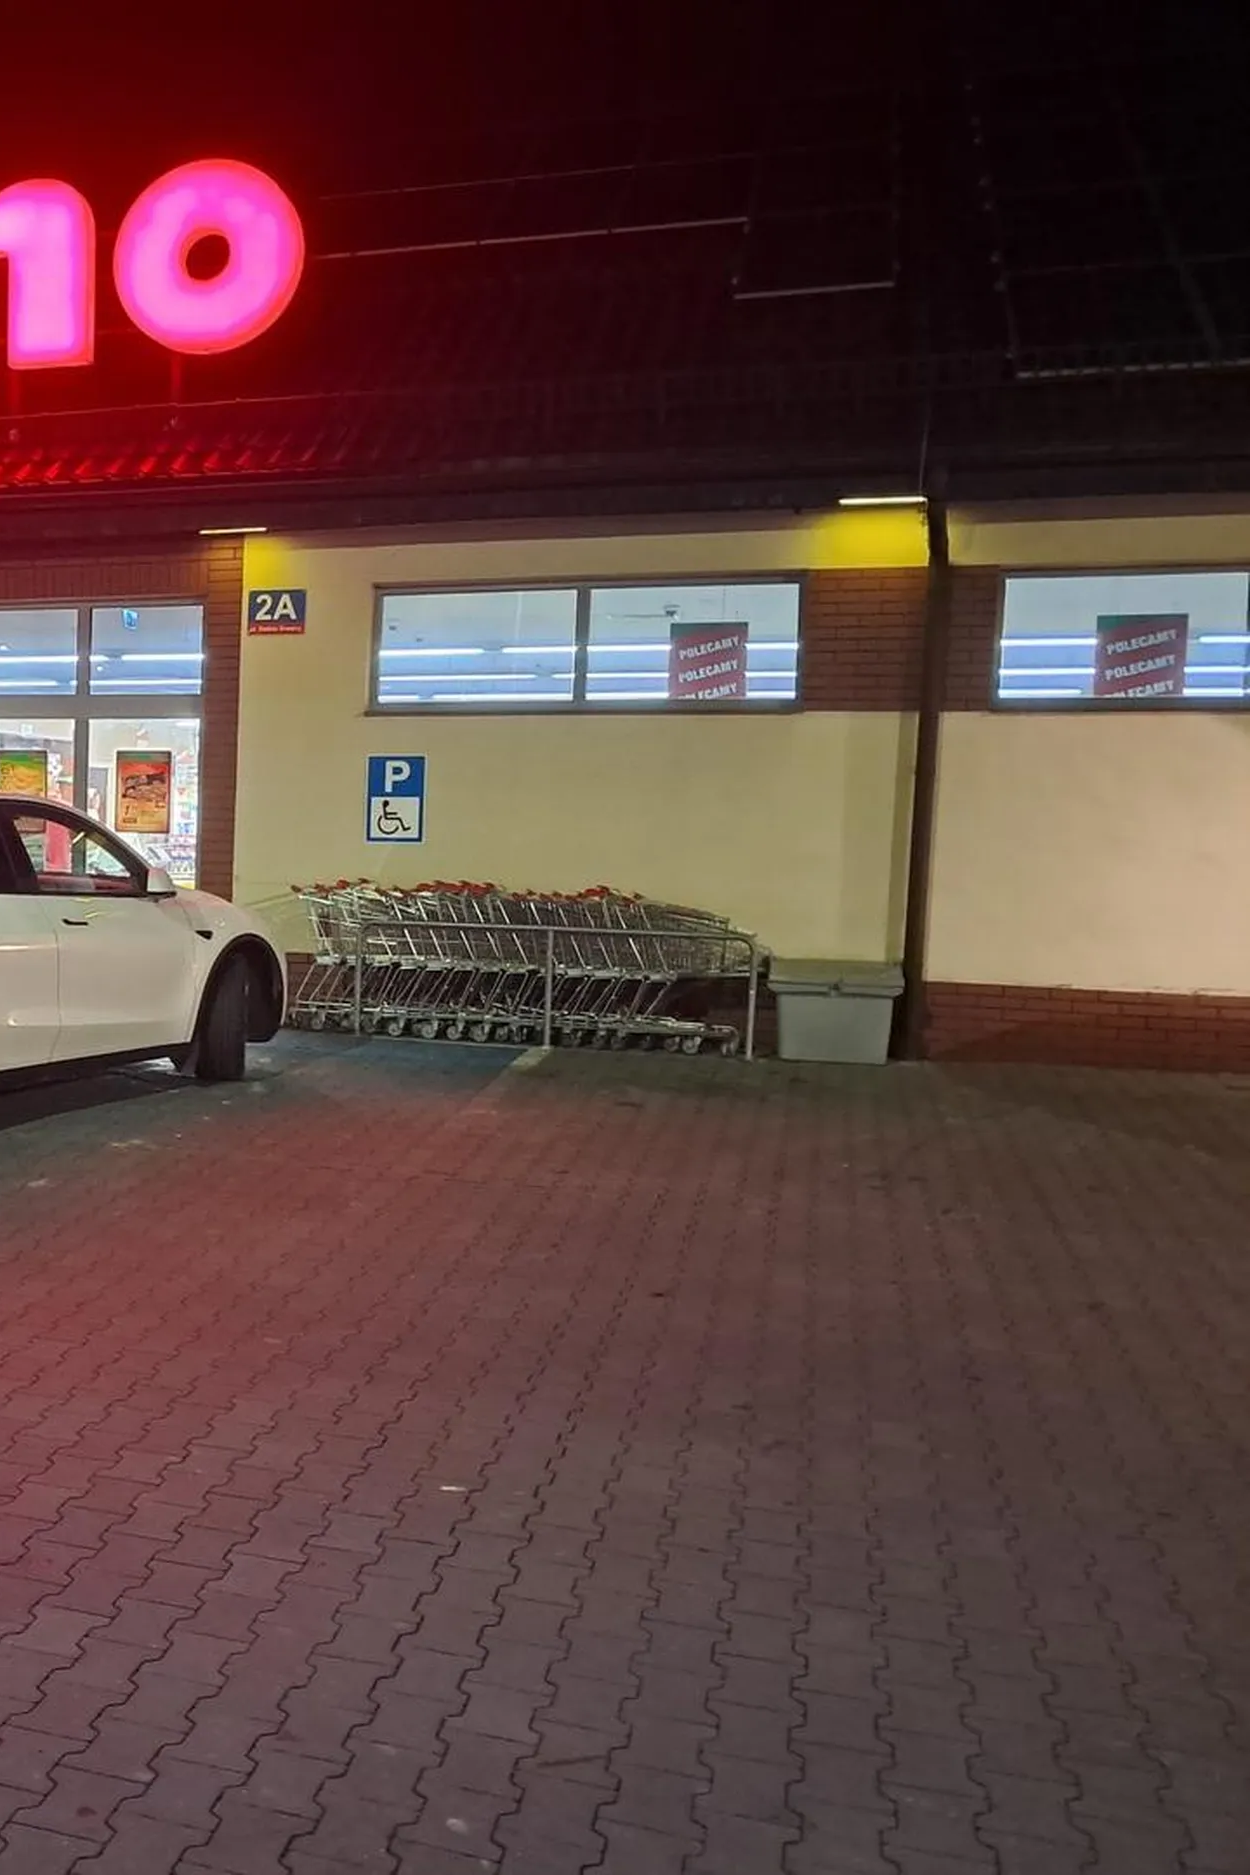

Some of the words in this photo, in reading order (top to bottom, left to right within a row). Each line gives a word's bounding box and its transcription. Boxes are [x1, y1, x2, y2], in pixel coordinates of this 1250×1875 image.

[255, 594, 297, 620] 2A
[678, 635, 739, 660] POLECAMY
[1105, 629, 1178, 655] POLECAMY
[677, 659, 738, 683] POLECAMY
[1103, 654, 1176, 680] POLECAMY
[677, 682, 737, 700] ECAMY
[1102, 680, 1175, 698] ECAMY
[385, 760, 410, 792] P
